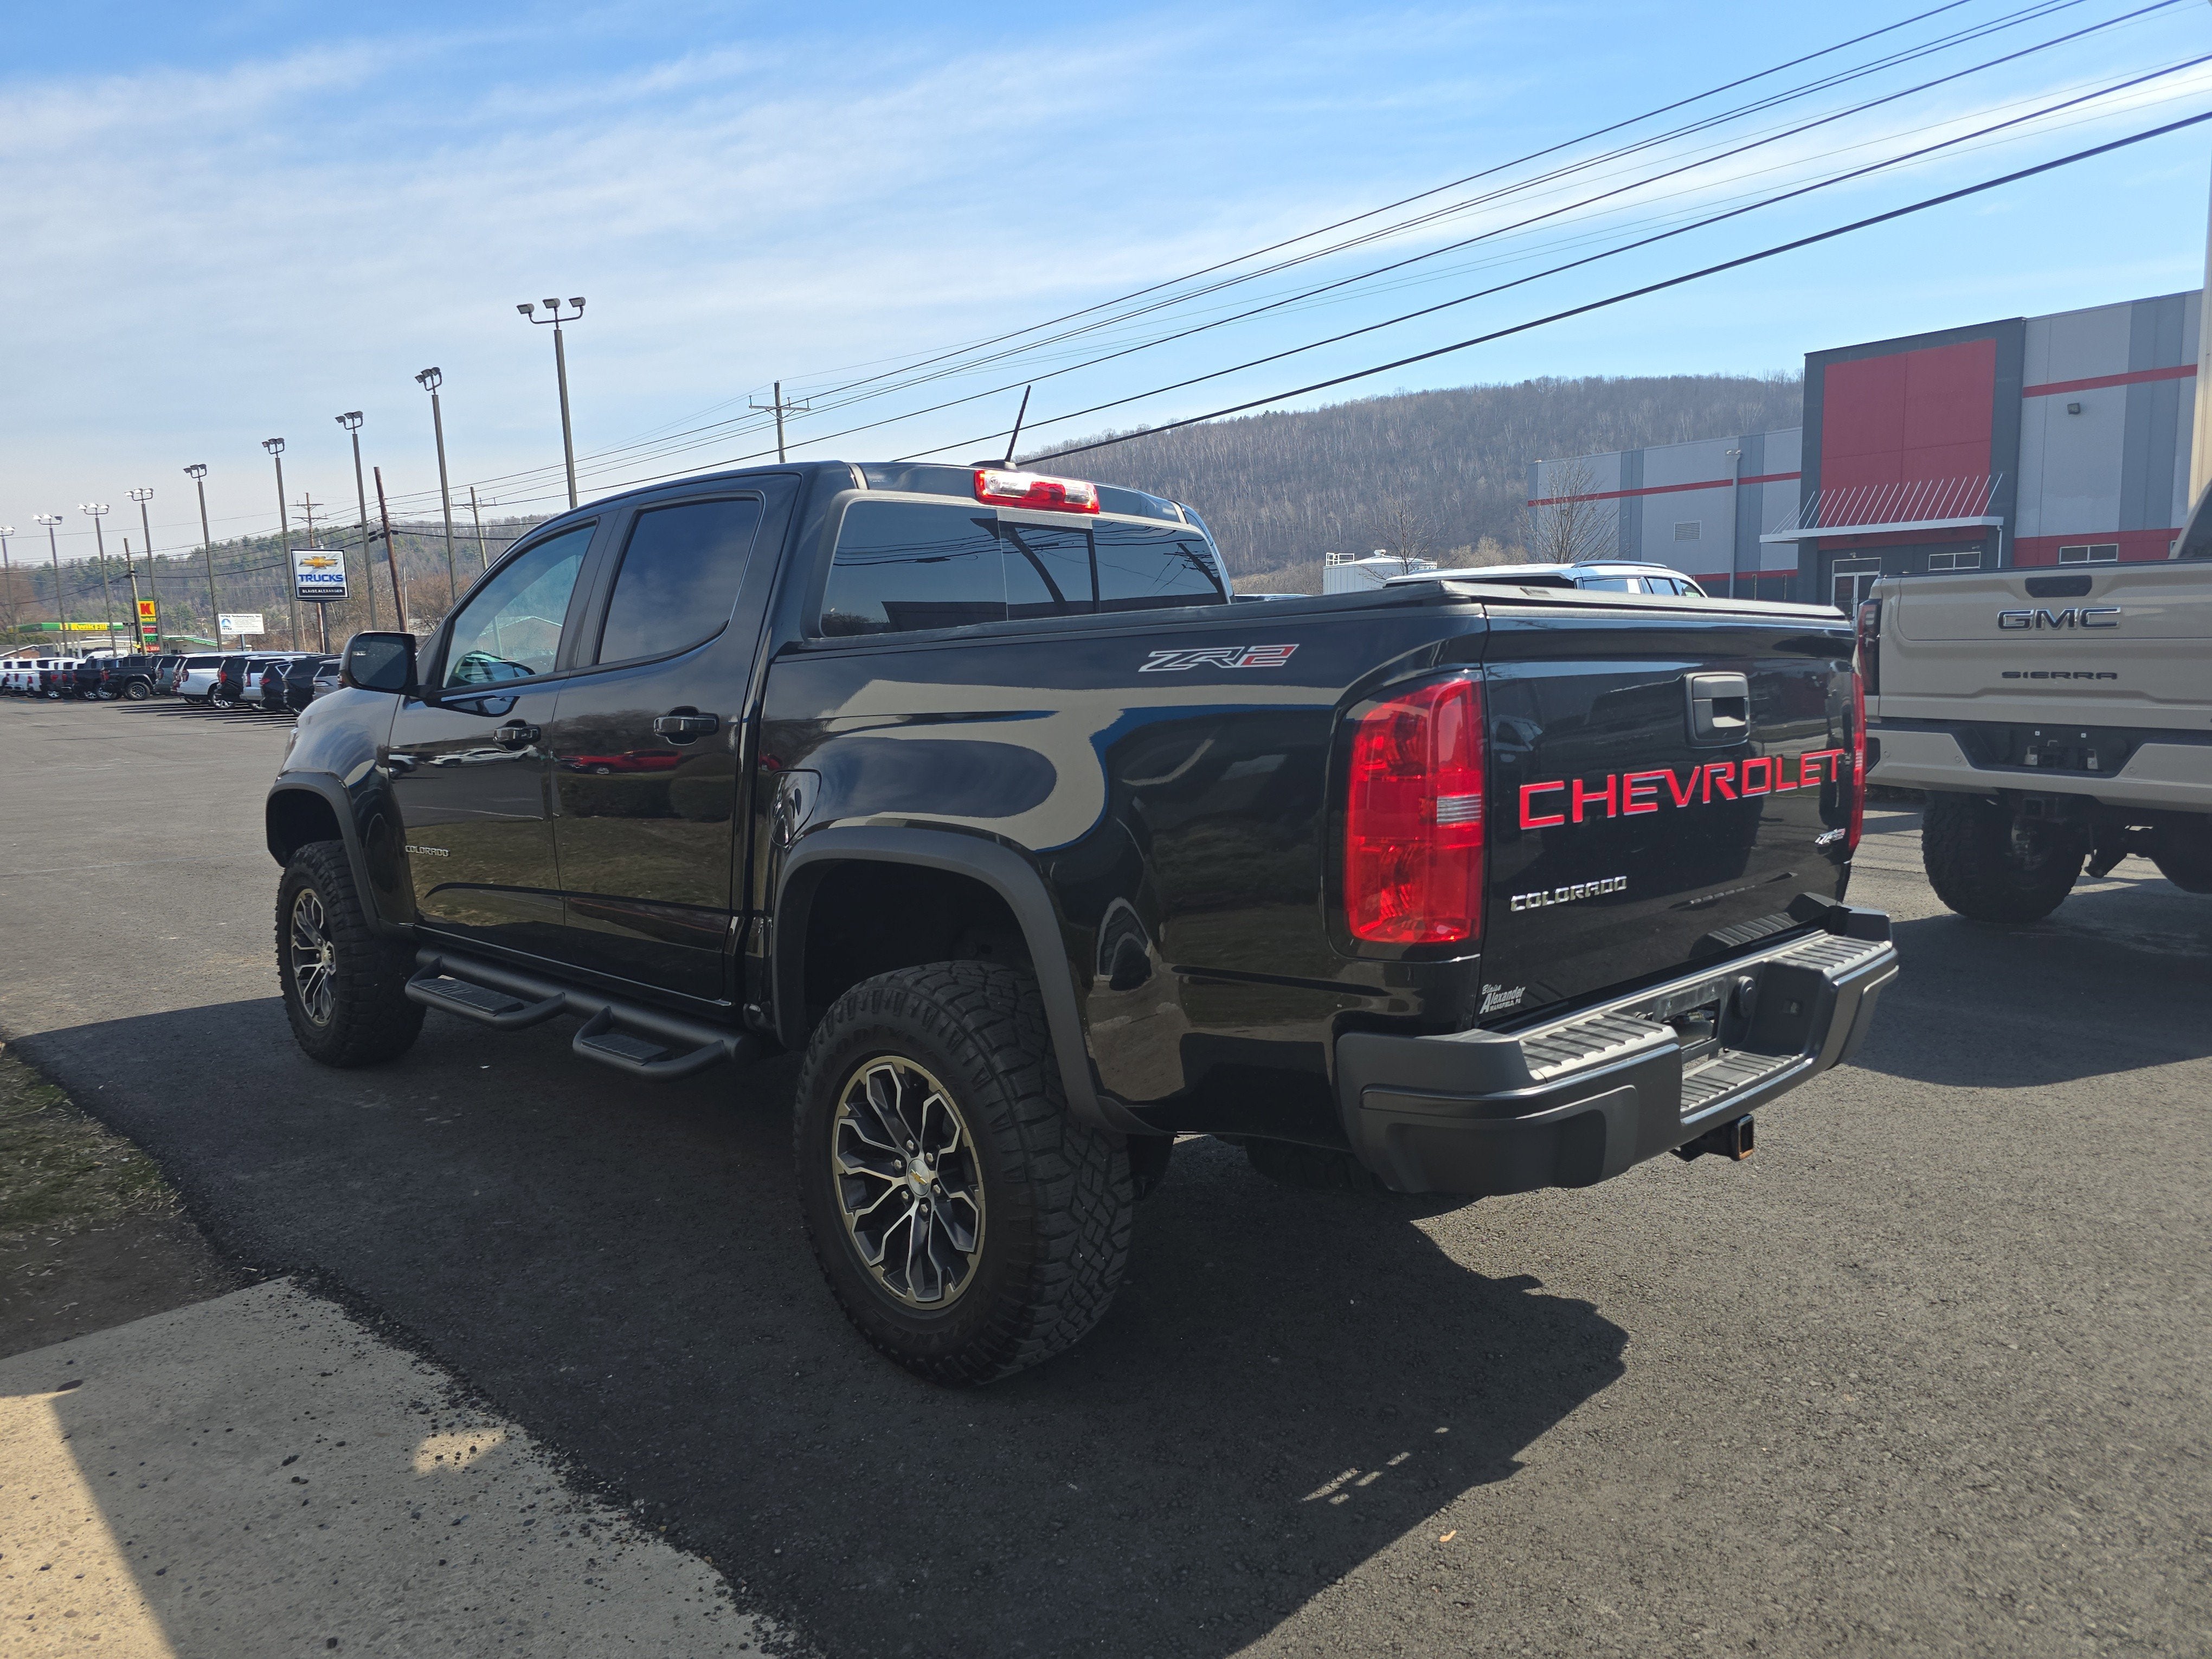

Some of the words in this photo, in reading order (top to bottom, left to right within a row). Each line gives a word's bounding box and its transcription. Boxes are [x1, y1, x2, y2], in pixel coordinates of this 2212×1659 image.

[298, 574, 344, 582] TRUCKS
[140, 603, 153, 615] K
[1997, 607, 2121, 631] GMC
[1139, 643, 1300, 672] ZR2
[2002, 671, 2118, 679] SIERRA
[1519, 749, 1845, 830] CHEVROLET
[405, 845, 449, 857] COLORADO
[1510, 876, 1628, 912] COLORADO
[1479, 986, 1526, 1014] Alexander
